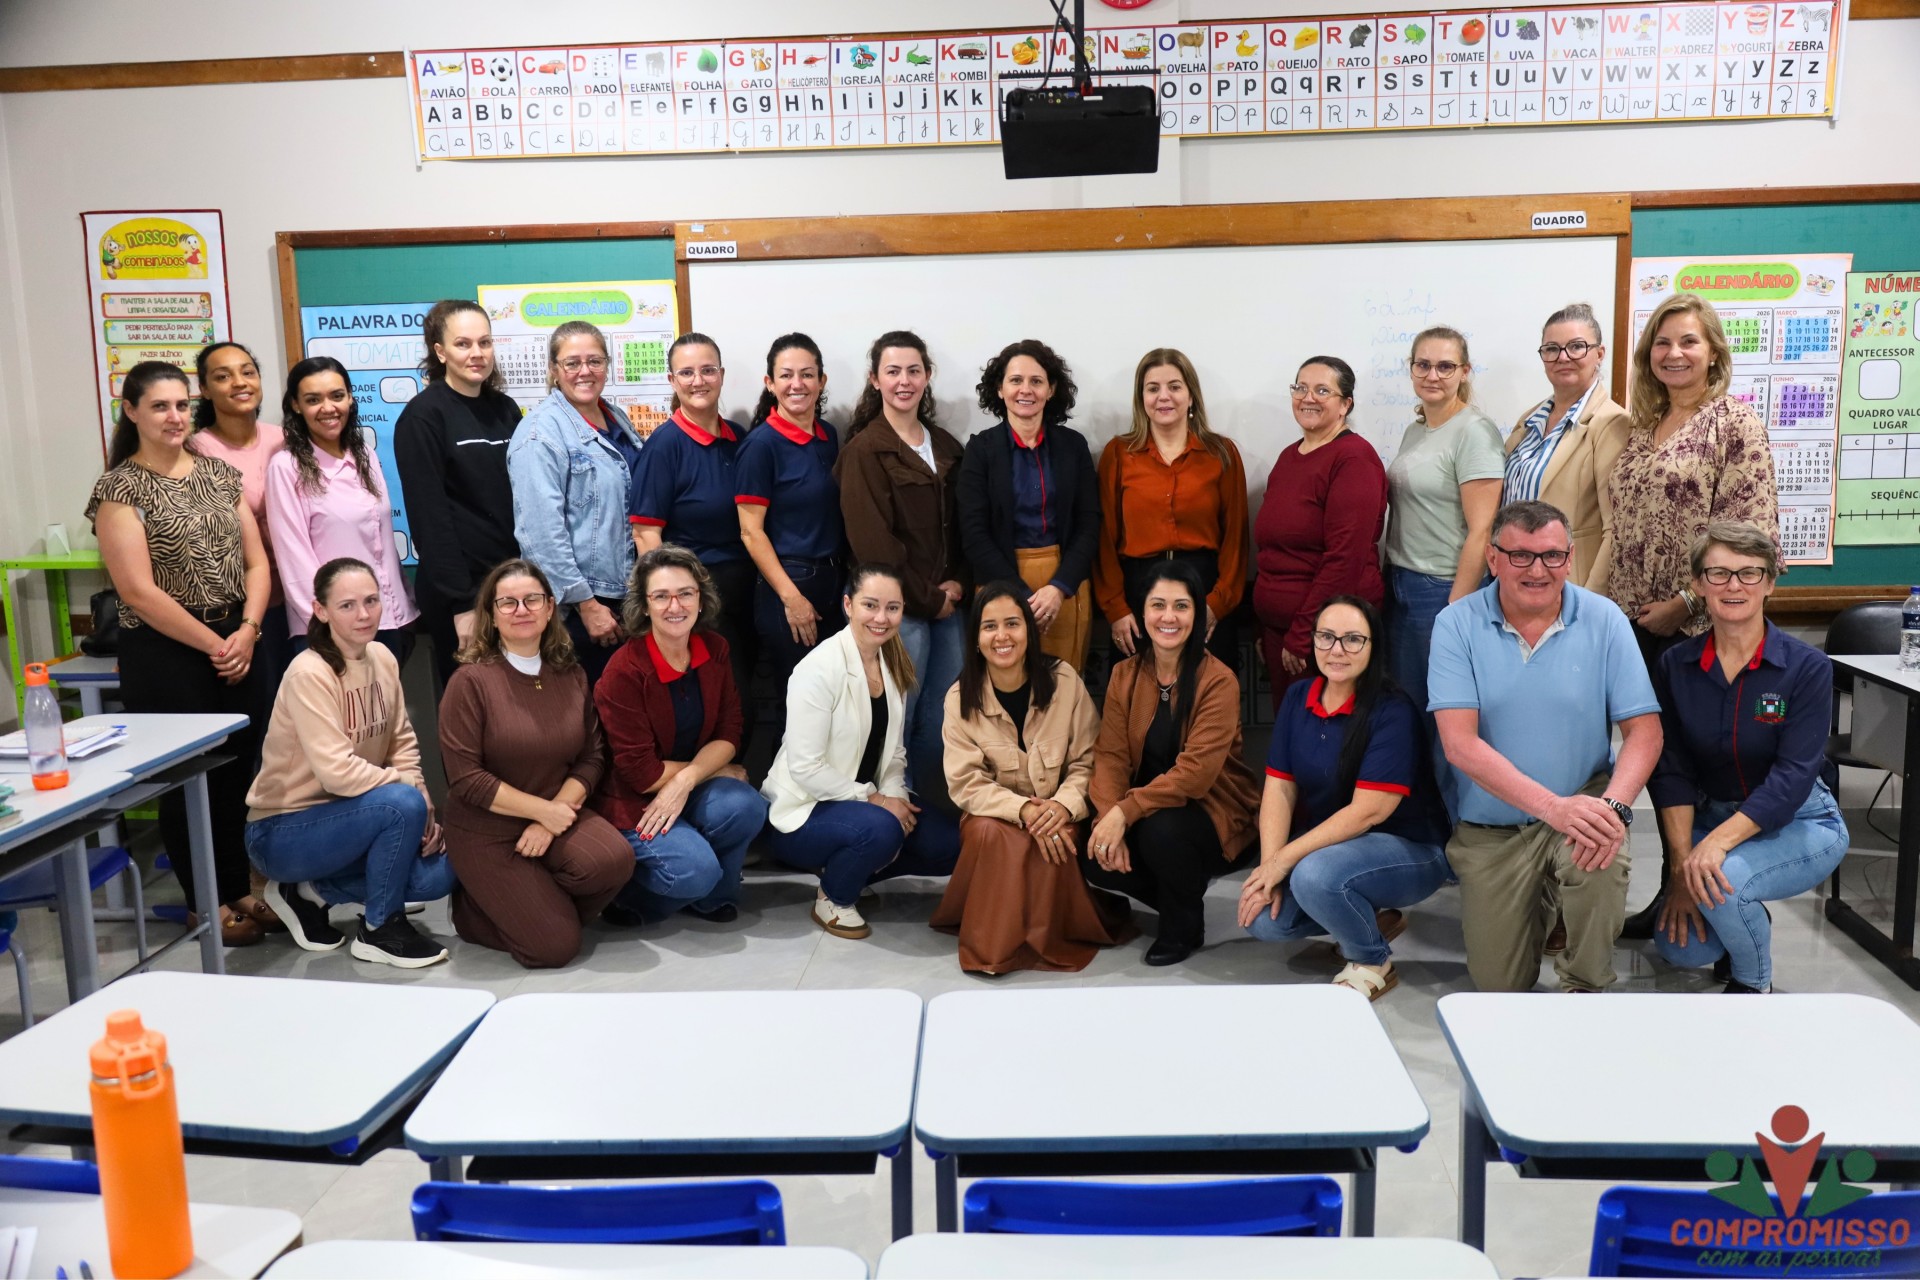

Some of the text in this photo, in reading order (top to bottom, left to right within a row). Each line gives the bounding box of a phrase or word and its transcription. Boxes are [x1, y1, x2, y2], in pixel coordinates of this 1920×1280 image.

[1608, 16, 1630, 33] W
[1666, 14, 1681, 31] X
[1724, 12, 1738, 30] Y
[1780, 10, 1794, 28] Z
[1439, 22, 1452, 40] T
[1495, 20, 1509, 38] U
[1551, 18, 1567, 35] V
[1270, 29, 1286, 47] Q
[1327, 27, 1342, 44] R
[1383, 24, 1397, 42] S
[1104, 36, 1118, 54] N
[1158, 34, 1176, 50] O
[1215, 32, 1228, 48] P
[942, 44, 956, 60] K
[996, 42, 1008, 58] L
[1615, 46, 1656, 56] WALTER
[1674, 44, 1714, 55] XADREZ
[1731, 42, 1772, 53] YOGURT
[1788, 41, 1824, 52] ZEBRA
[729, 50, 744, 66] G
[782, 48, 796, 65] H
[888, 46, 900, 62] J
[1394, 54, 1428, 65] SAPO
[1446, 52, 1484, 63] TOMATE
[1509, 50, 1534, 60] UVA
[1563, 48, 1597, 59] VACA
[522, 57, 536, 73] C
[573, 55, 586, 72] D
[624, 54, 638, 70] E
[676, 52, 688, 68] F
[1278, 59, 1318, 70] QUEIJO
[1338, 57, 1370, 68] RATO
[422, 60, 436, 76] A
[472, 58, 485, 75] B
[1167, 63, 1206, 74] OVELHA
[1227, 61, 1258, 72] PATO
[788, 76, 828, 87] HELICÓPTERO
[840, 74, 881, 86] IGREJA
[892, 72, 934, 83] JACARÉ
[950, 71, 987, 82] KOMBI
[584, 84, 617, 94] DADO
[630, 82, 672, 92] ELEFANTE
[684, 80, 723, 91] FOLHA
[741, 78, 772, 88] GATO
[430, 86, 466, 98] AVIÃO
[482, 87, 516, 96] BOLA
[530, 86, 569, 96] CARRO
[1533, 214, 1585, 226] QUADRO
[125, 230, 178, 248] NOSSOS
[688, 246, 735, 255] QUADRO
[124, 256, 185, 266] COMBINADOS
[1681, 272, 1794, 289] CALENDÁRIO
[525, 299, 627, 317] CALENDÁRIO
[318, 314, 424, 330] PALAVRA DO
[344, 342, 423, 365] TOMATE
[1849, 348, 1914, 357] ANTECESSOR
[1849, 409, 1894, 419] QUADRO
[1873, 421, 1908, 429] LUGAR
[1871, 489, 1920, 500] SEQUÊNC
